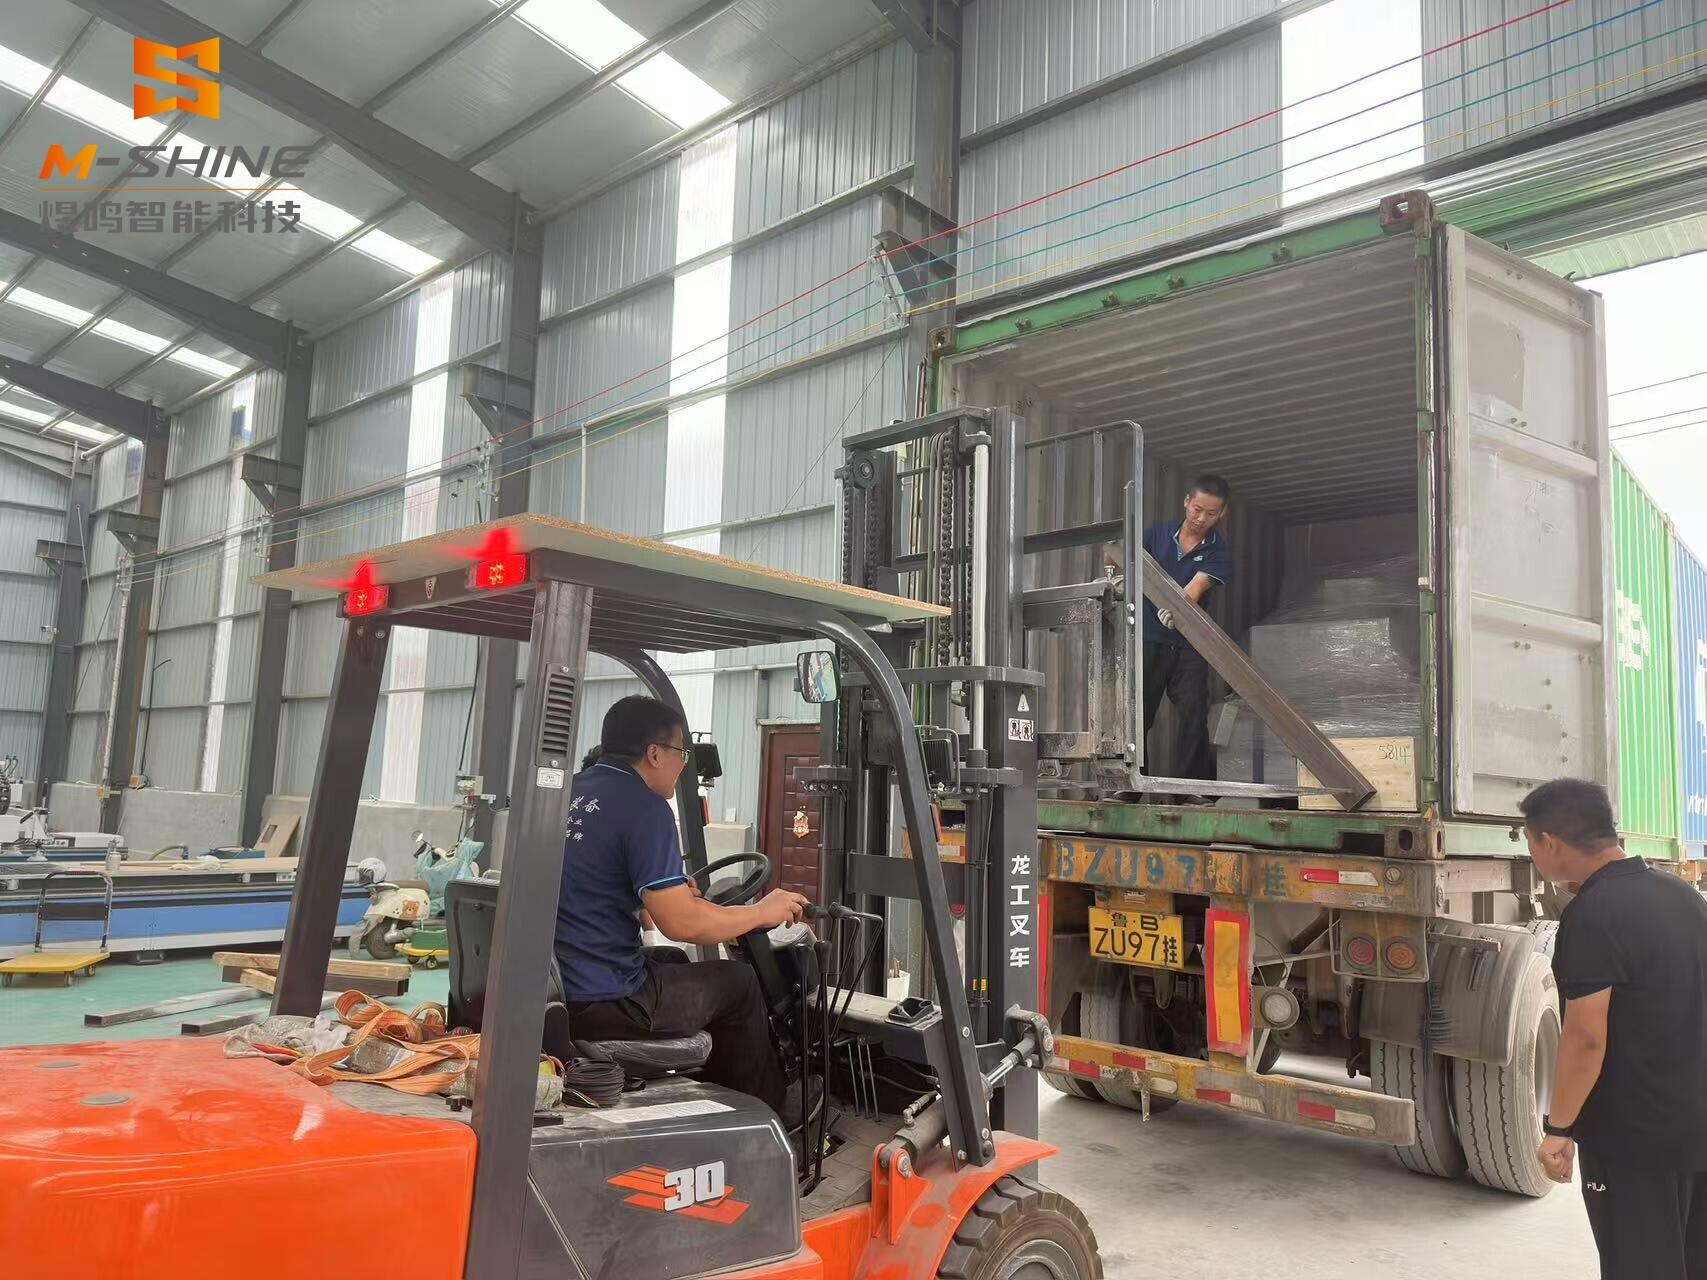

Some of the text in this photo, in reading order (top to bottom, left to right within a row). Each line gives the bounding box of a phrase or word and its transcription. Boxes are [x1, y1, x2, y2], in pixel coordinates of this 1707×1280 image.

[1009, 855, 1031, 968] 龙工叉车
[1094, 926, 1178, 966] ZU97挂
[664, 1160, 725, 1212] 30
